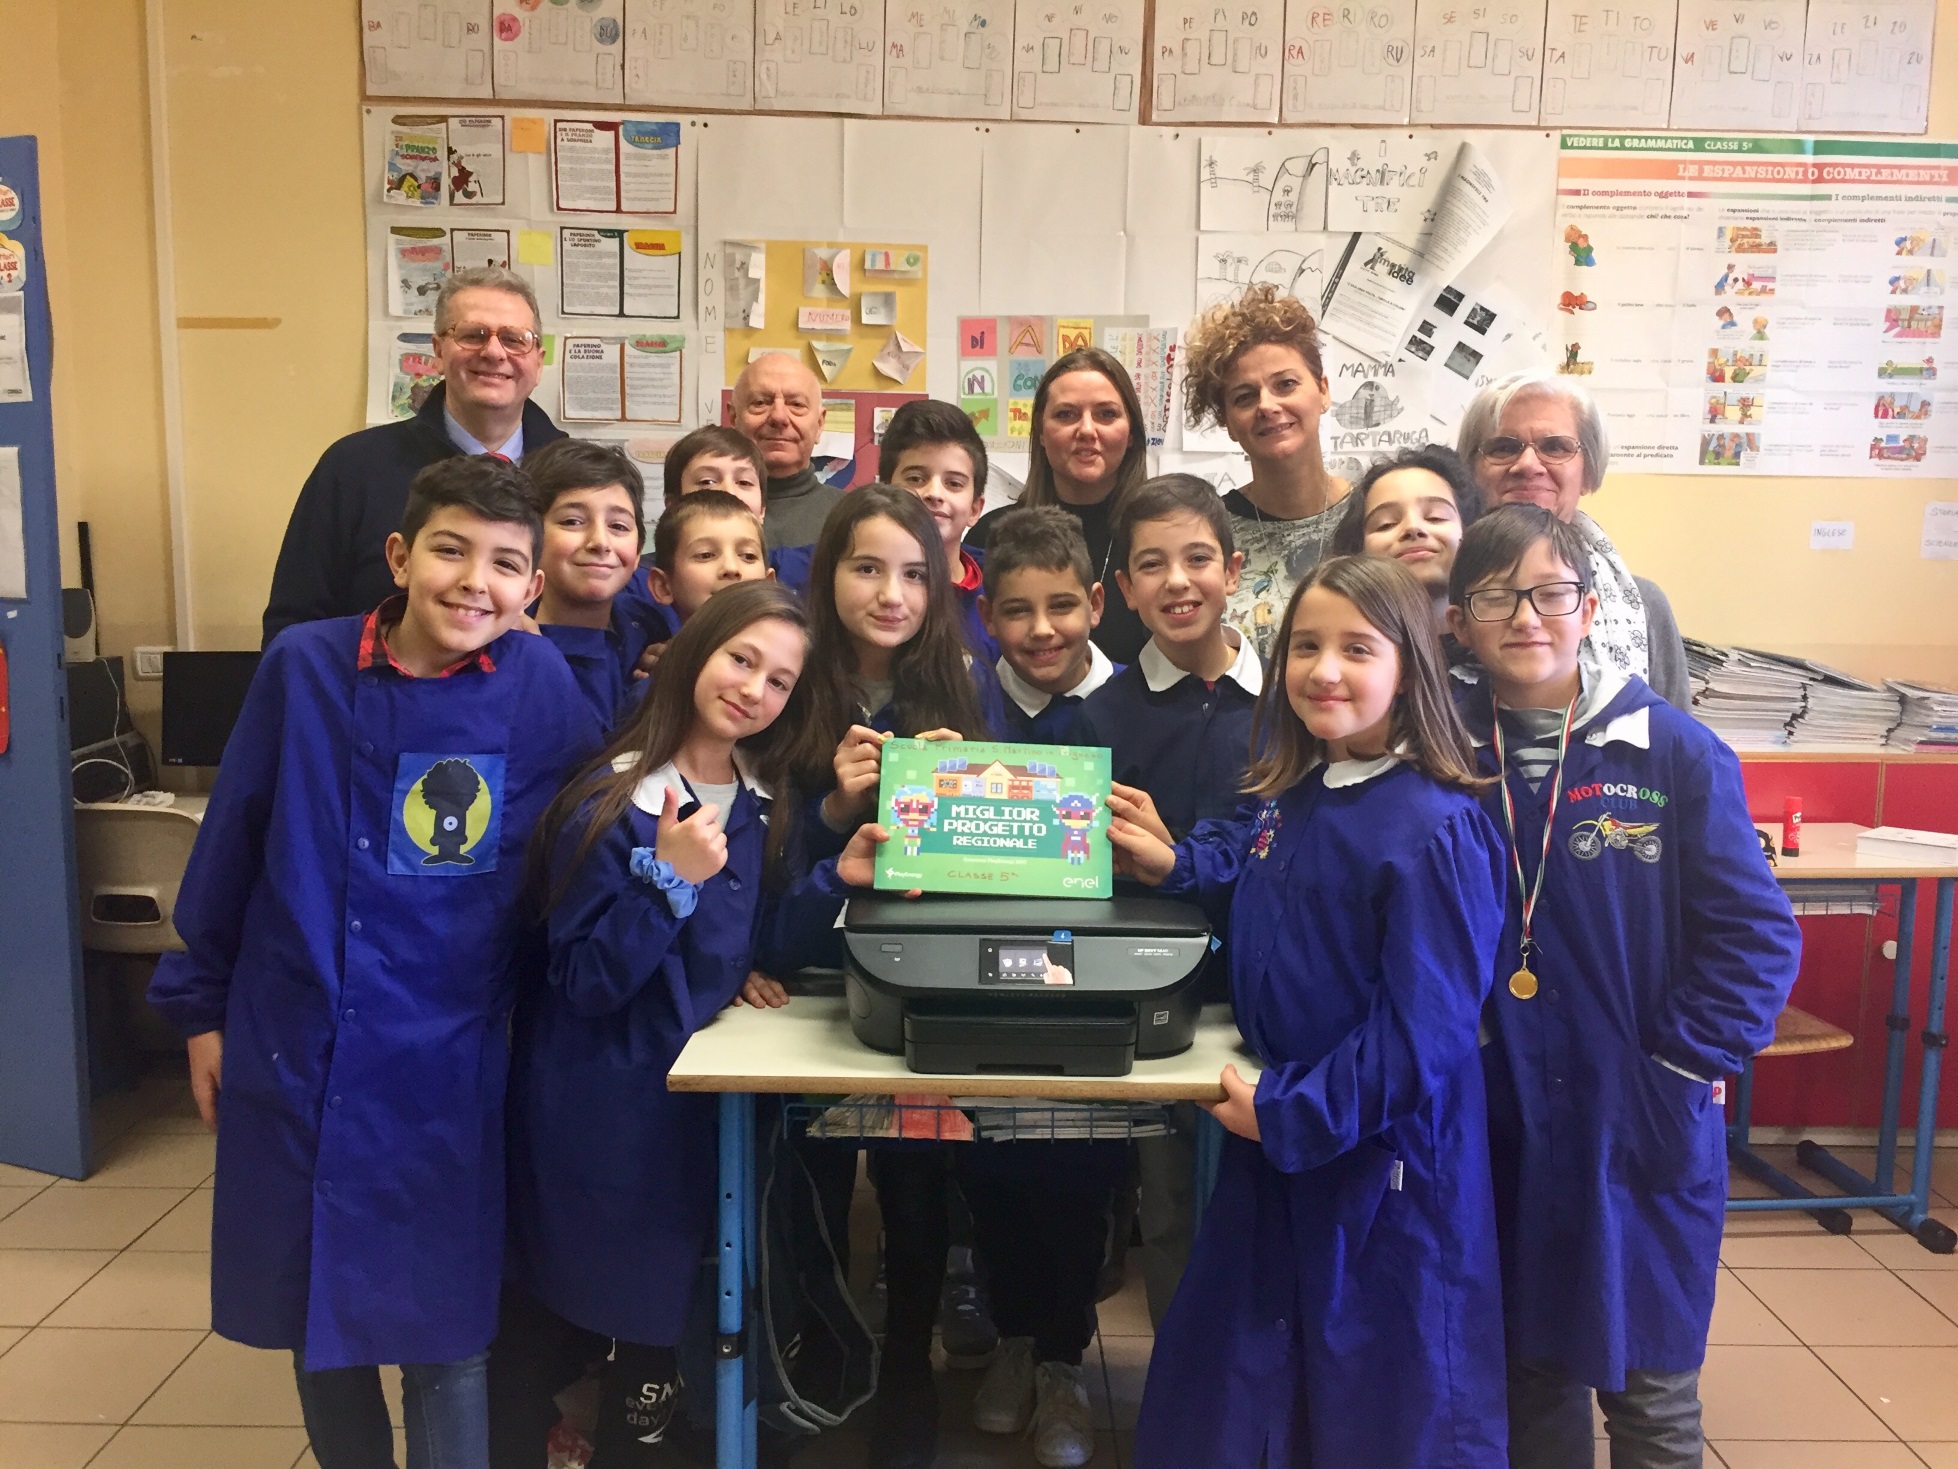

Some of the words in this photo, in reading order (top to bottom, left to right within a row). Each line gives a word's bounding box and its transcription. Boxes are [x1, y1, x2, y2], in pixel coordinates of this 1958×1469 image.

[763, 27, 783, 46] LA
[784, 3, 800, 17] LE
[839, 2, 858, 17] LO
[858, 38, 876, 53] LU
[1703, 19, 1719, 31] VE
[1161, 46, 1175, 60] PA
[1182, 17, 1196, 31] PE
[1241, 10, 1259, 27] PO
[1288, 44, 1307, 61] RA
[1311, 11, 1334, 29] RE
[1342, 7, 1357, 25] RI
[1369, 12, 1389, 29] RO
[1420, 44, 1437, 59] SA
[1442, 10, 1457, 25] SE
[1472, 7, 1487, 20] SI
[1500, 12, 1519, 25] SO
[1518, 46, 1536, 62] SU
[1547, 47, 1567, 65] TA
[1570, 13, 1589, 34] TE
[1602, 9, 1620, 27] TI
[1632, 15, 1652, 32] TO
[1647, 45, 1669, 63] TU
[889, 41, 905, 58] MA
[1566, 136, 1604, 147] VEDERE
[1608, 138, 1621, 148] LA
[1624, 138, 1695, 149] GRAMMATICA
[1704, 140, 1738, 150] CLASSE
[1329, 162, 1428, 188] MAGNIFICI
[1677, 164, 1699, 177] LE
[1702, 164, 1804, 180] ESPANSIONI
[1807, 168, 1818, 180] O
[1823, 167, 1949, 183] COMPLEMENTI
[1591, 190, 1651, 198] complemento
[1653, 191, 1686, 199] oggetto
[1842, 194, 1902, 203] complementi
[1904, 195, 1943, 203] indiretti
[1355, 195, 1400, 213] TRE
[0, 262, 18, 272] LASSE
[1388, 268, 1414, 286] idee
[1008, 324, 1042, 355] A
[1338, 362, 1396, 379] MAMMA
[1330, 427, 1430, 450] TARTARUGA
[1813, 528, 1848, 537] INGLESE
[890, 740, 927, 751] Scuola
[935, 742, 985, 753] Primaria
[1566, 783, 1668, 807] MOTOCROSS
[1601, 797, 1638, 809] CLUB
[951, 804, 1040, 821] MIGLIOR
[943, 819, 1047, 837] PROGETTO
[952, 835, 1037, 849] REGIONALE
[947, 870, 994, 880] CLASSE
[1062, 876, 1099, 889] enel
